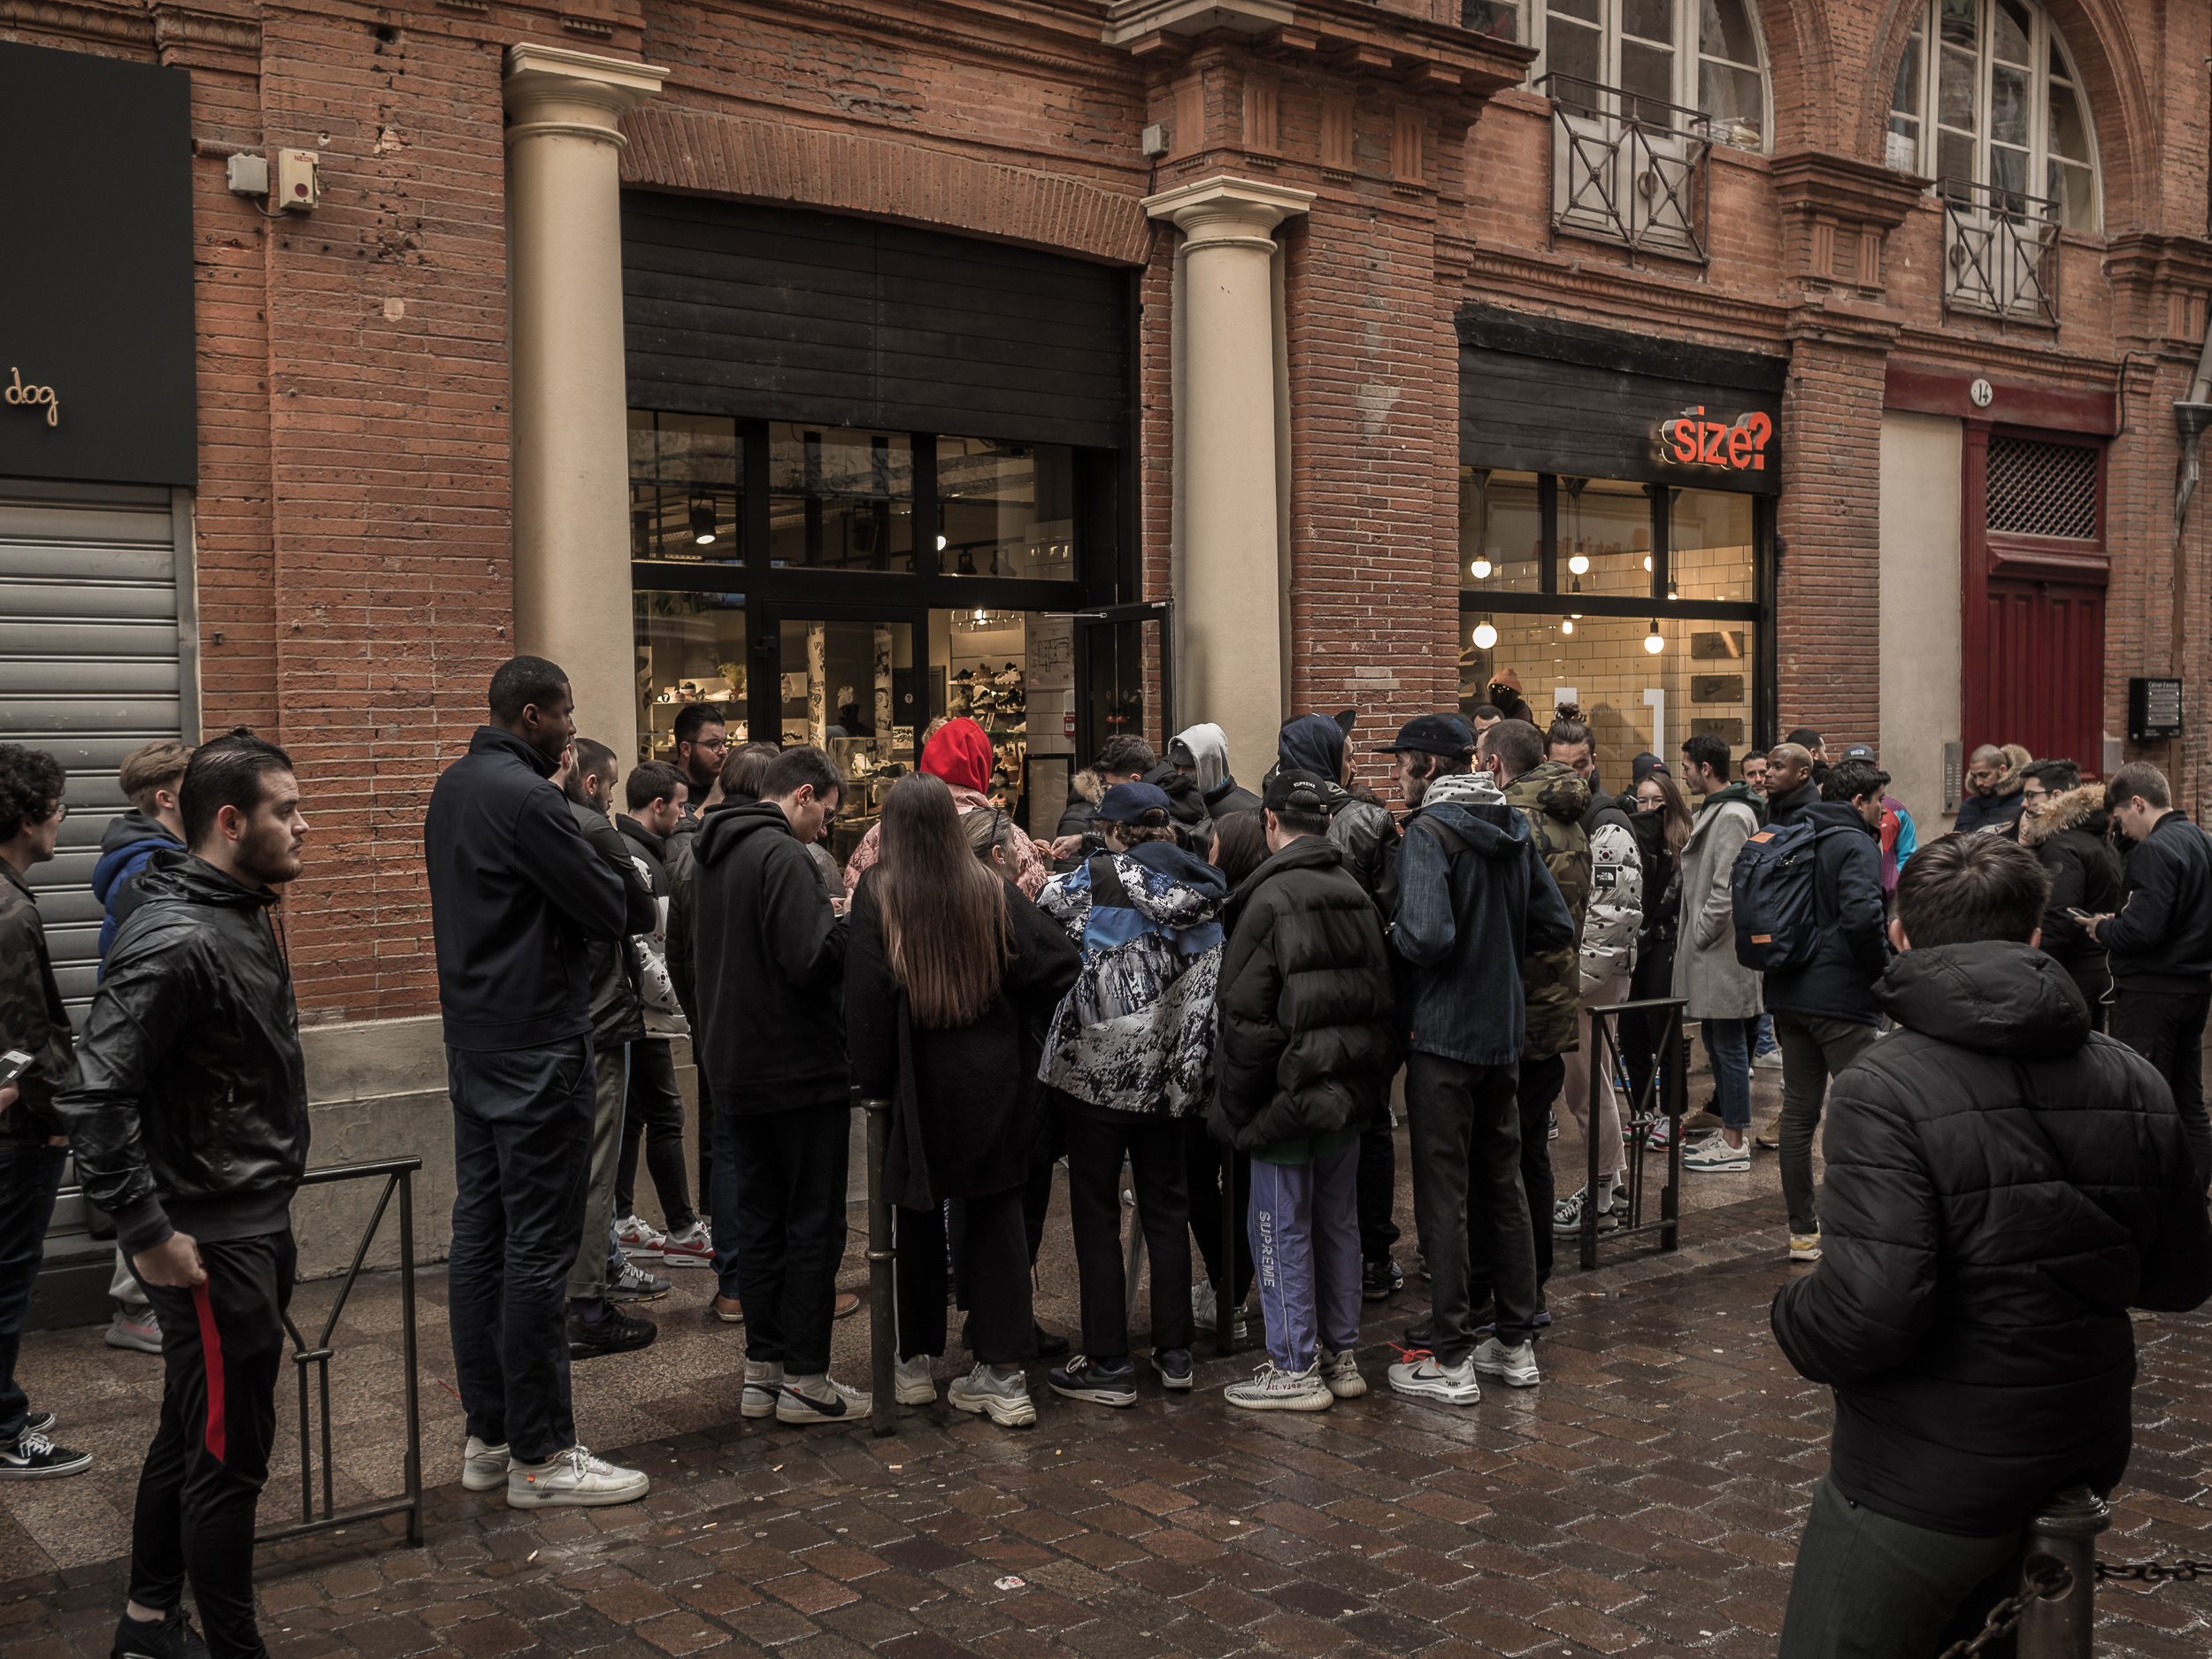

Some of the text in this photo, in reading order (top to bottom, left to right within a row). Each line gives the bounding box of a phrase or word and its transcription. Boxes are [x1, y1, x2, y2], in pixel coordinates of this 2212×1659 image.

[294, 154, 315, 163] NEON
[5, 366, 59, 427] dog
[1978, 381, 1990, 403] 14
[1673, 404, 1772, 471] size?
[1259, 1210, 1275, 1287] SUPREME
